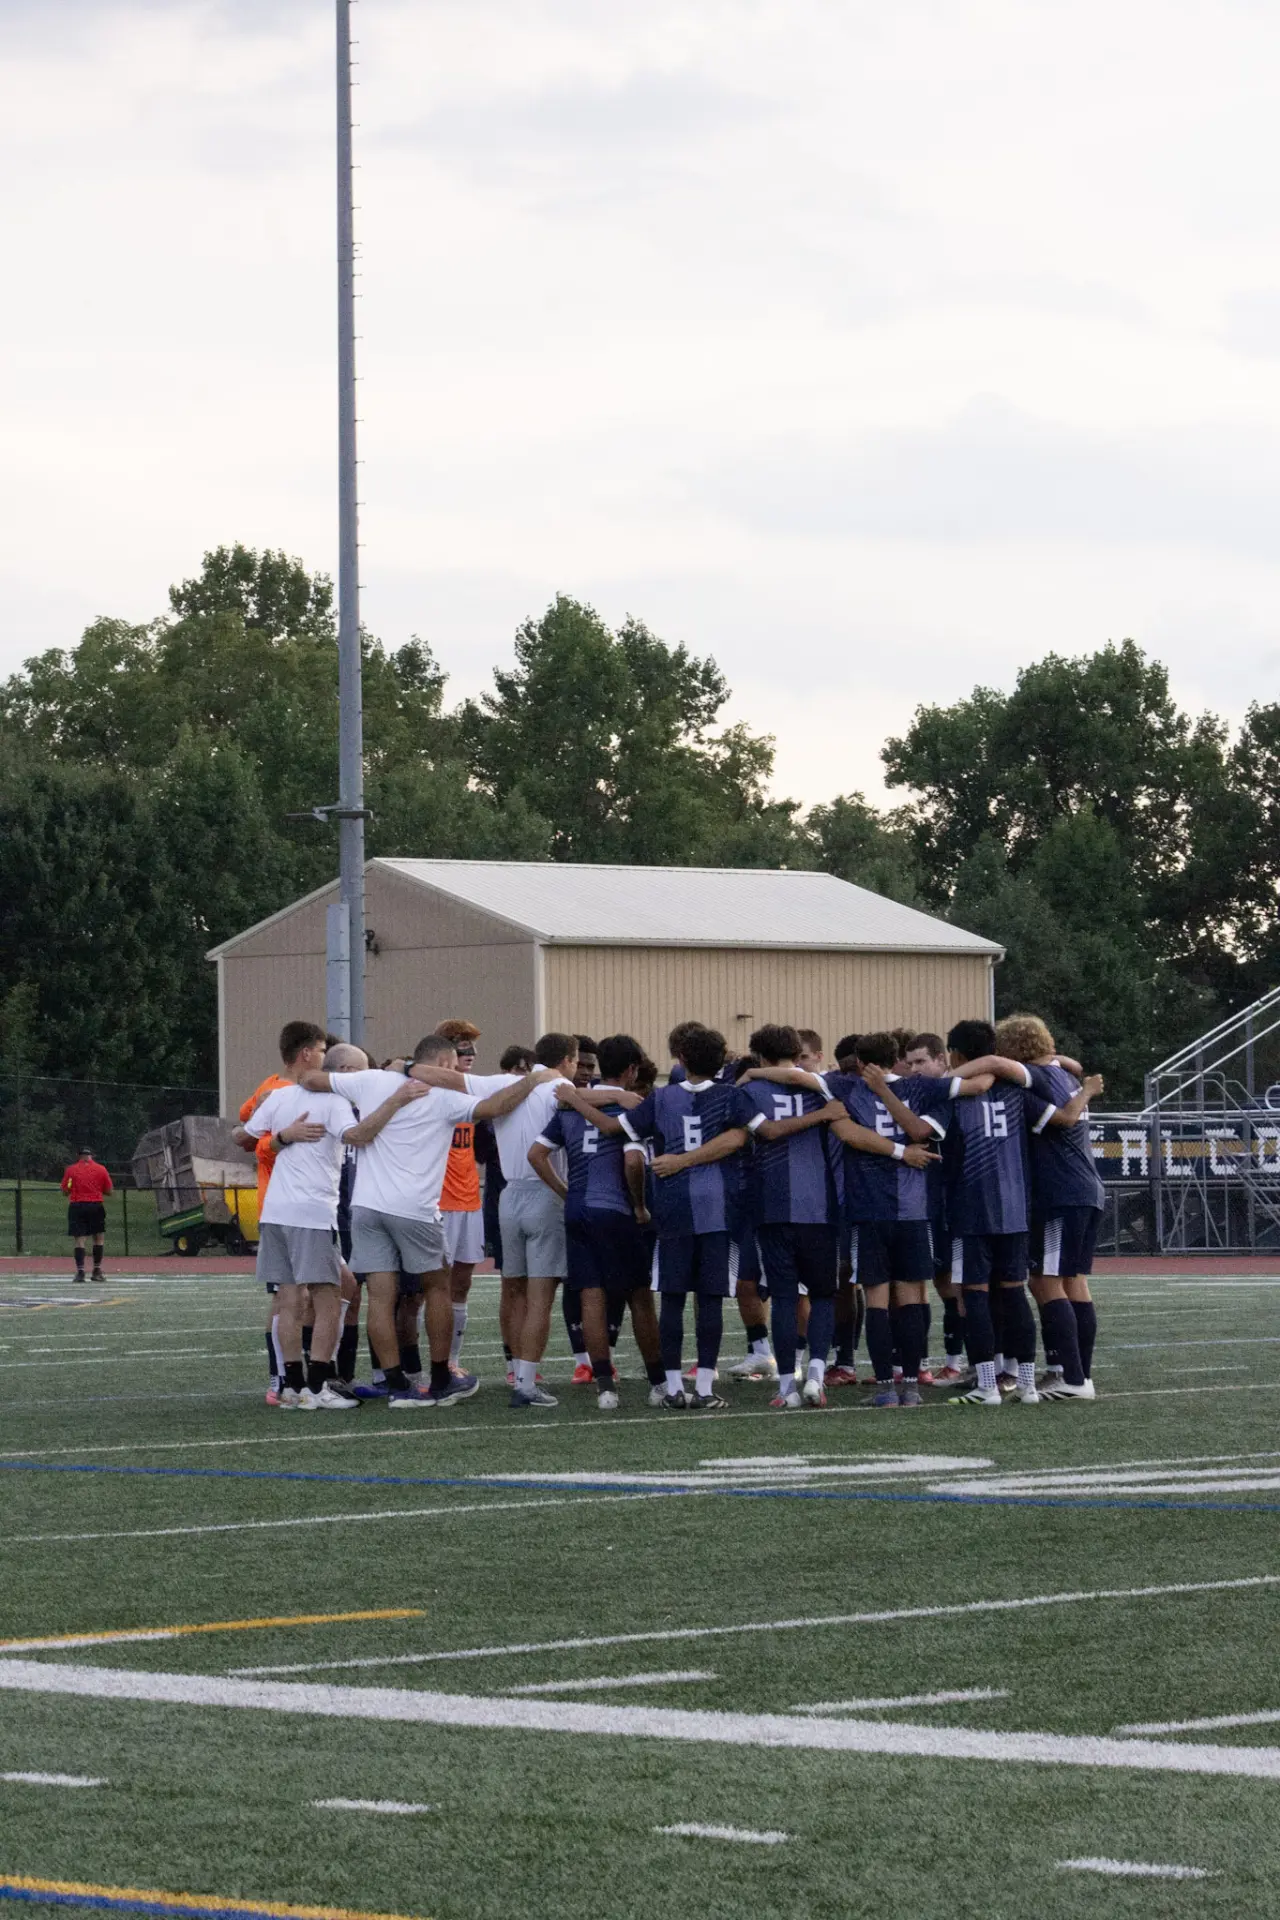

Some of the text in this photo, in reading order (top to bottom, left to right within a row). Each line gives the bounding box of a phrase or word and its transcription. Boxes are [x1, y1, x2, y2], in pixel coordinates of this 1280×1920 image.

[582, 1119, 599, 1153] 2
[682, 1115, 702, 1151] 6
[982, 1101, 1008, 1137] 15
